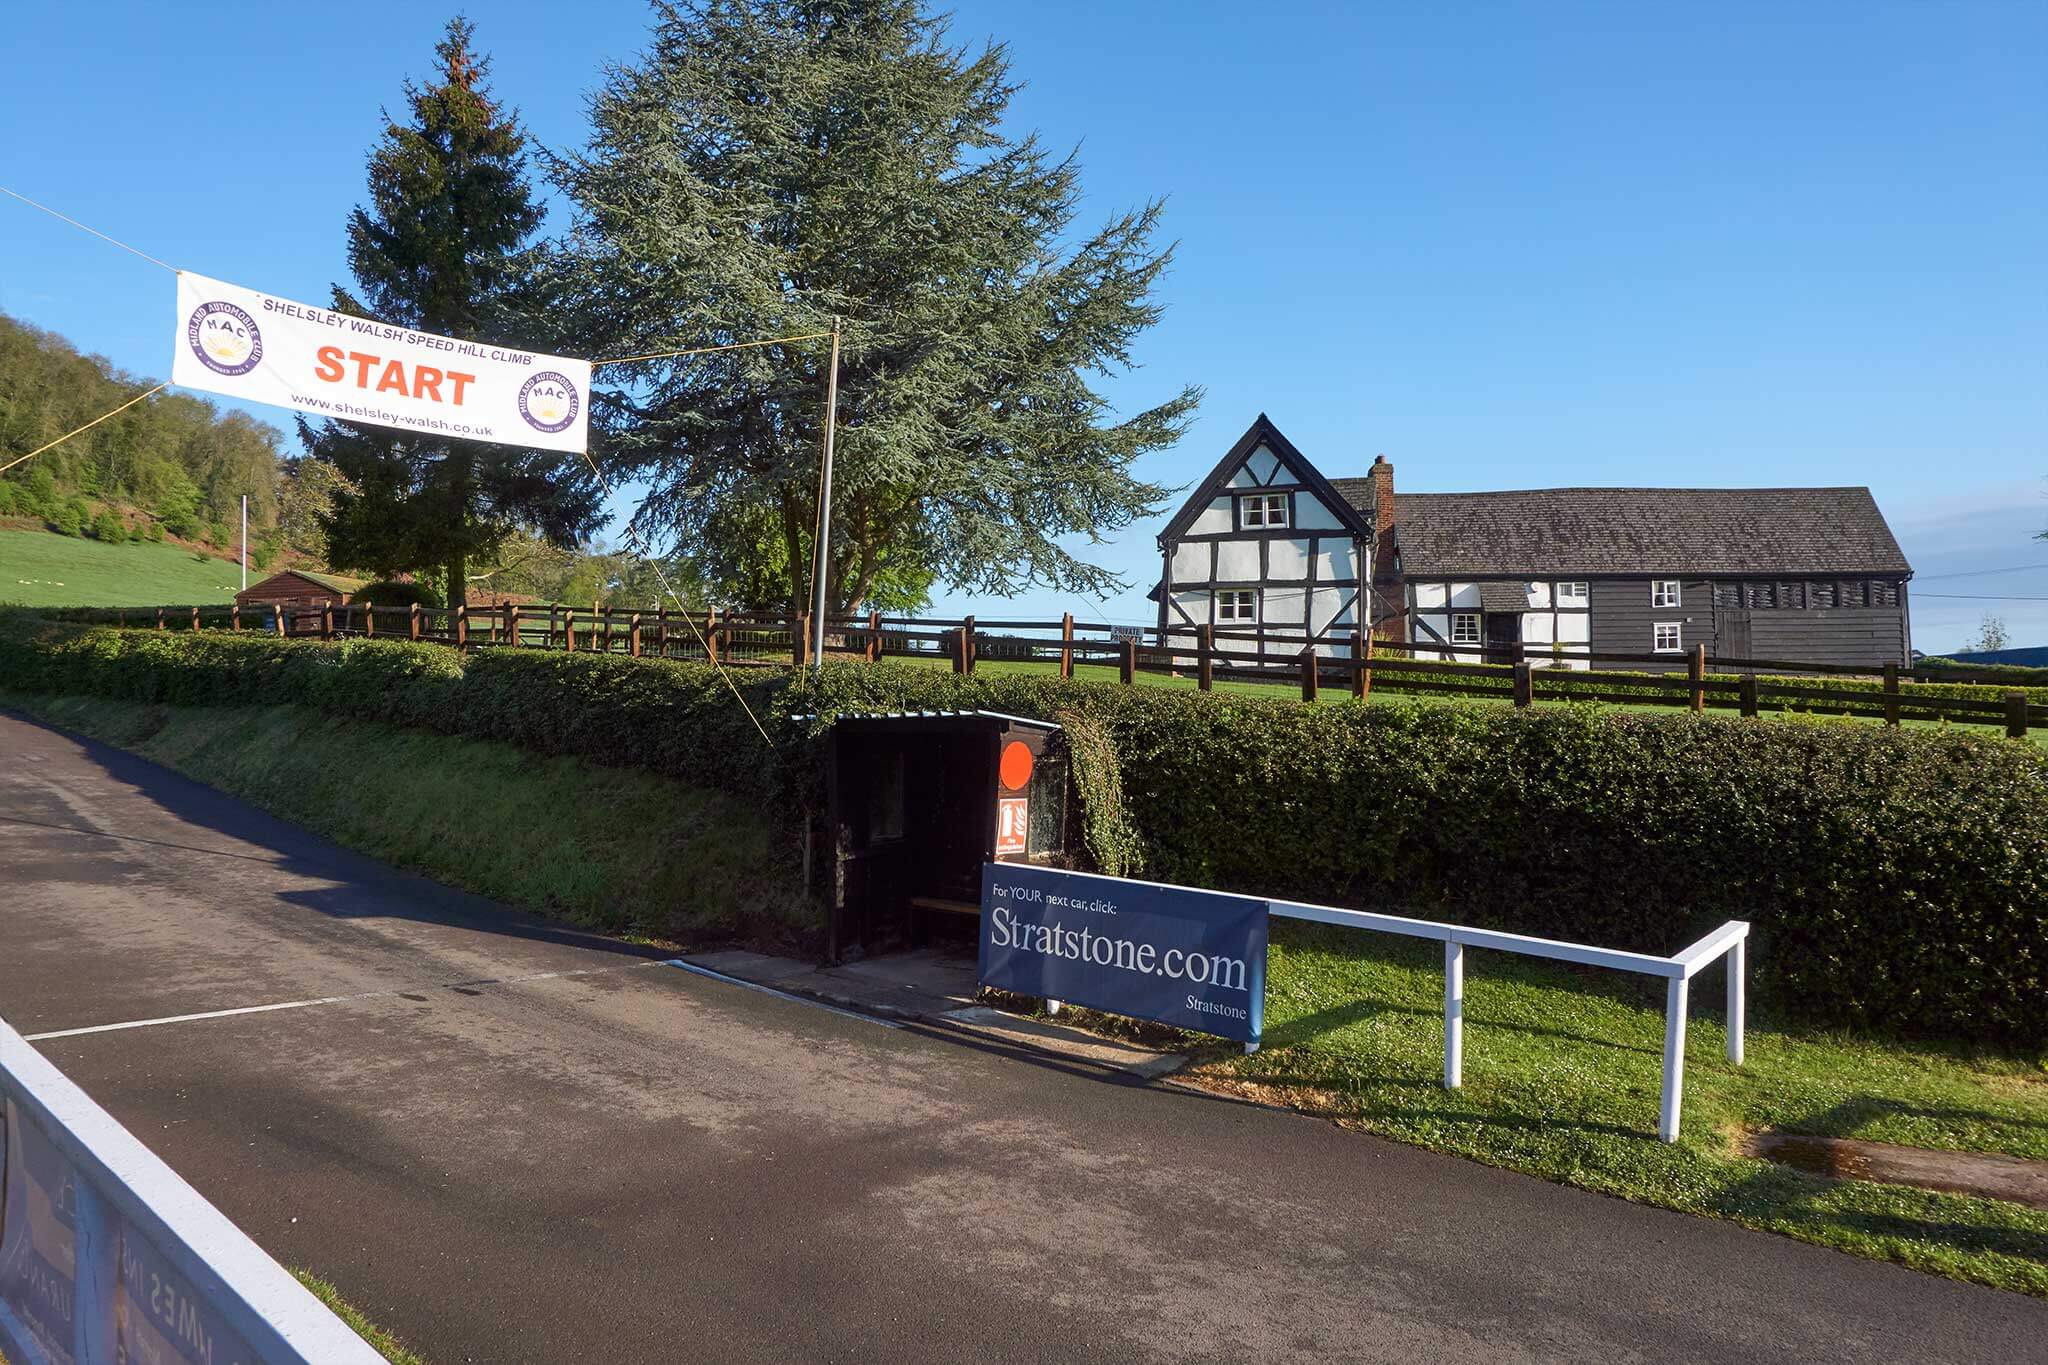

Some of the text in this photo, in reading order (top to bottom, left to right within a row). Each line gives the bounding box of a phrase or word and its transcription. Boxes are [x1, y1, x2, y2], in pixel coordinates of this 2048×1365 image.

[189, 303, 262, 362] MIDLAND AUTOMOBILE CLUB
[206, 319, 246, 338] MAC
[263, 299, 532, 366] SHELSLEY WALSH SPEED HILL CLIMB
[314, 345, 476, 406] START
[519, 372, 578, 418] MIDLAND AUTOMOBILE CLUB
[533, 386, 565, 400] MAC
[291, 392, 495, 438] www.shelsley-walsh.co.uk
[993, 883, 1009, 897] For
[1009, 886, 1042, 903] YOUR
[1045, 894, 1068, 907] next
[1090, 899, 1117, 916] click:
[991, 907, 1249, 992] Stratstone.com
[1185, 994, 1247, 1020] Stratstone
